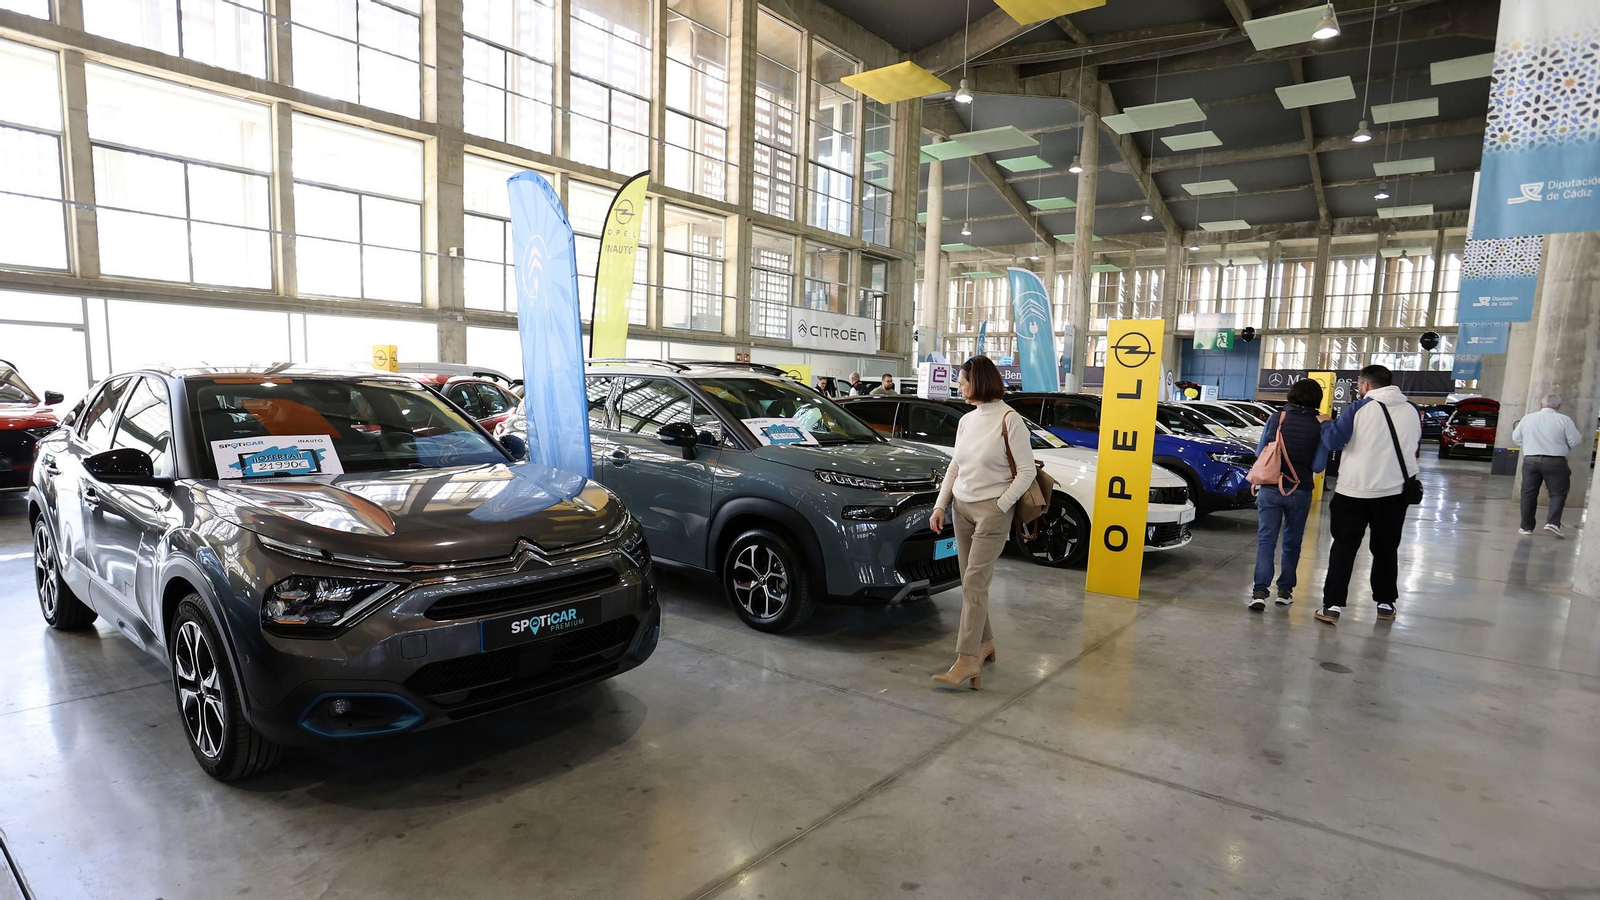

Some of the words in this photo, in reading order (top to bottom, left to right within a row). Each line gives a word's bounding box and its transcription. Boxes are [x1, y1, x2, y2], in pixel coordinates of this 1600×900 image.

[1546, 191, 1560, 201] de
[1562, 188, 1593, 200] Cádiz
[607, 229, 636, 238] OPEL
[930, 384, 948, 392] HYBRID
[1103, 379, 1143, 552] OPEL
[550, 618, 585, 632] PREMIUM
